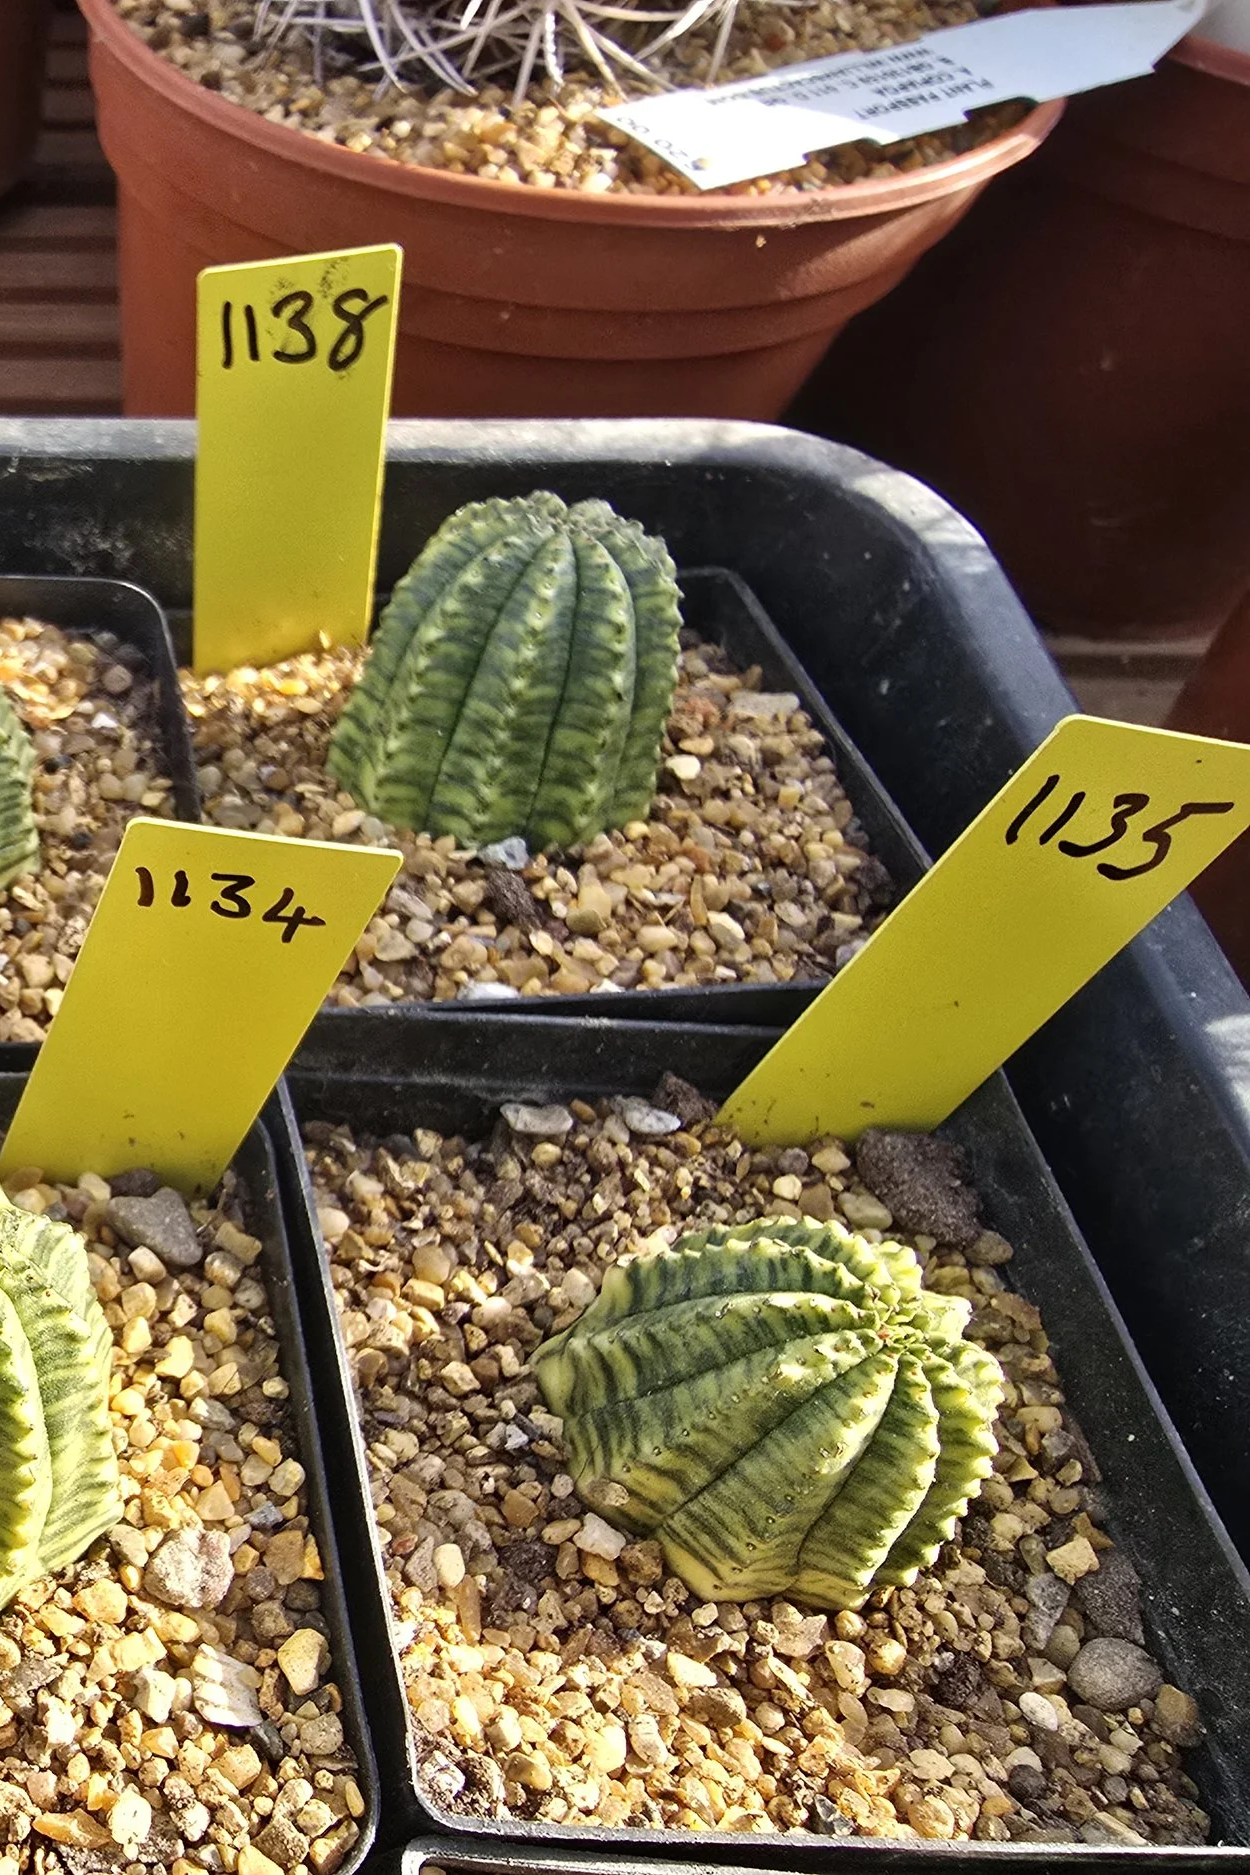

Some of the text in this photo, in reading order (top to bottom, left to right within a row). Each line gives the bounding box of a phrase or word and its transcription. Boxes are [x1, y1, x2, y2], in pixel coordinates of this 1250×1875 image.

[852, 78, 996, 120] PLANT PASSPORT
[222, 288, 388, 372] 1138
[1004, 774, 1235, 881] 1135
[135, 866, 327, 944] 1134
